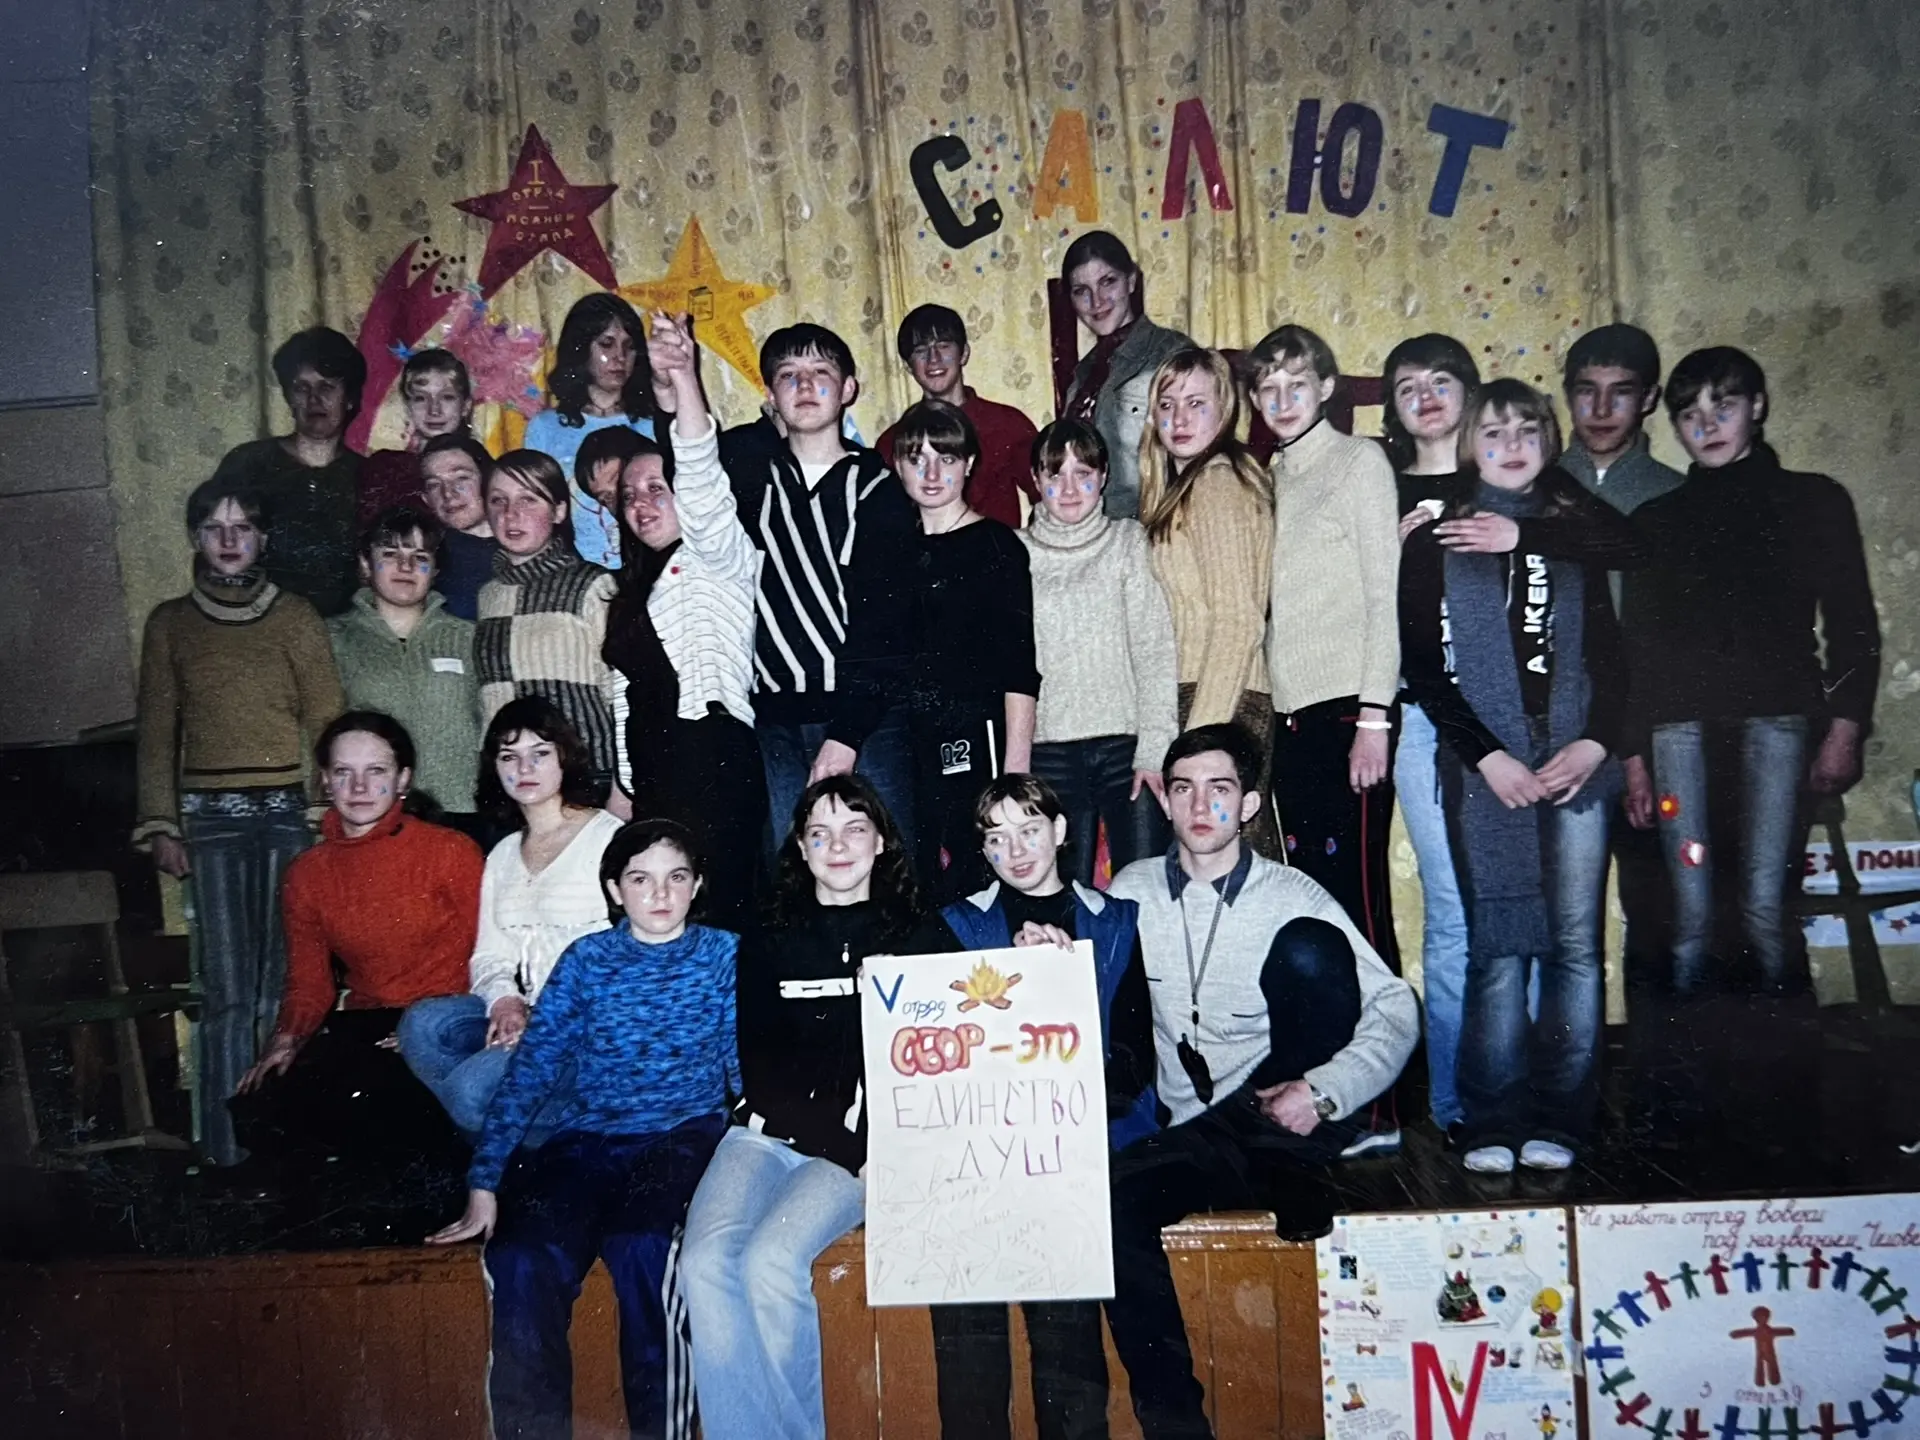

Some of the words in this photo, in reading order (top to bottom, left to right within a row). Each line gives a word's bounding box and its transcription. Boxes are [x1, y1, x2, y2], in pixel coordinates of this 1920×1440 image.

[909, 97, 1510, 249] САЛЮТ
[871, 973, 904, 1014] V
[902, 1001, 947, 1023] отряд
[891, 1022, 985, 1077] СБОР
[1016, 1022, 1081, 1064] ЭТО
[891, 1078, 1088, 1131] ЕДИНСТВО
[945, 1133, 1062, 1182] ДУШ
